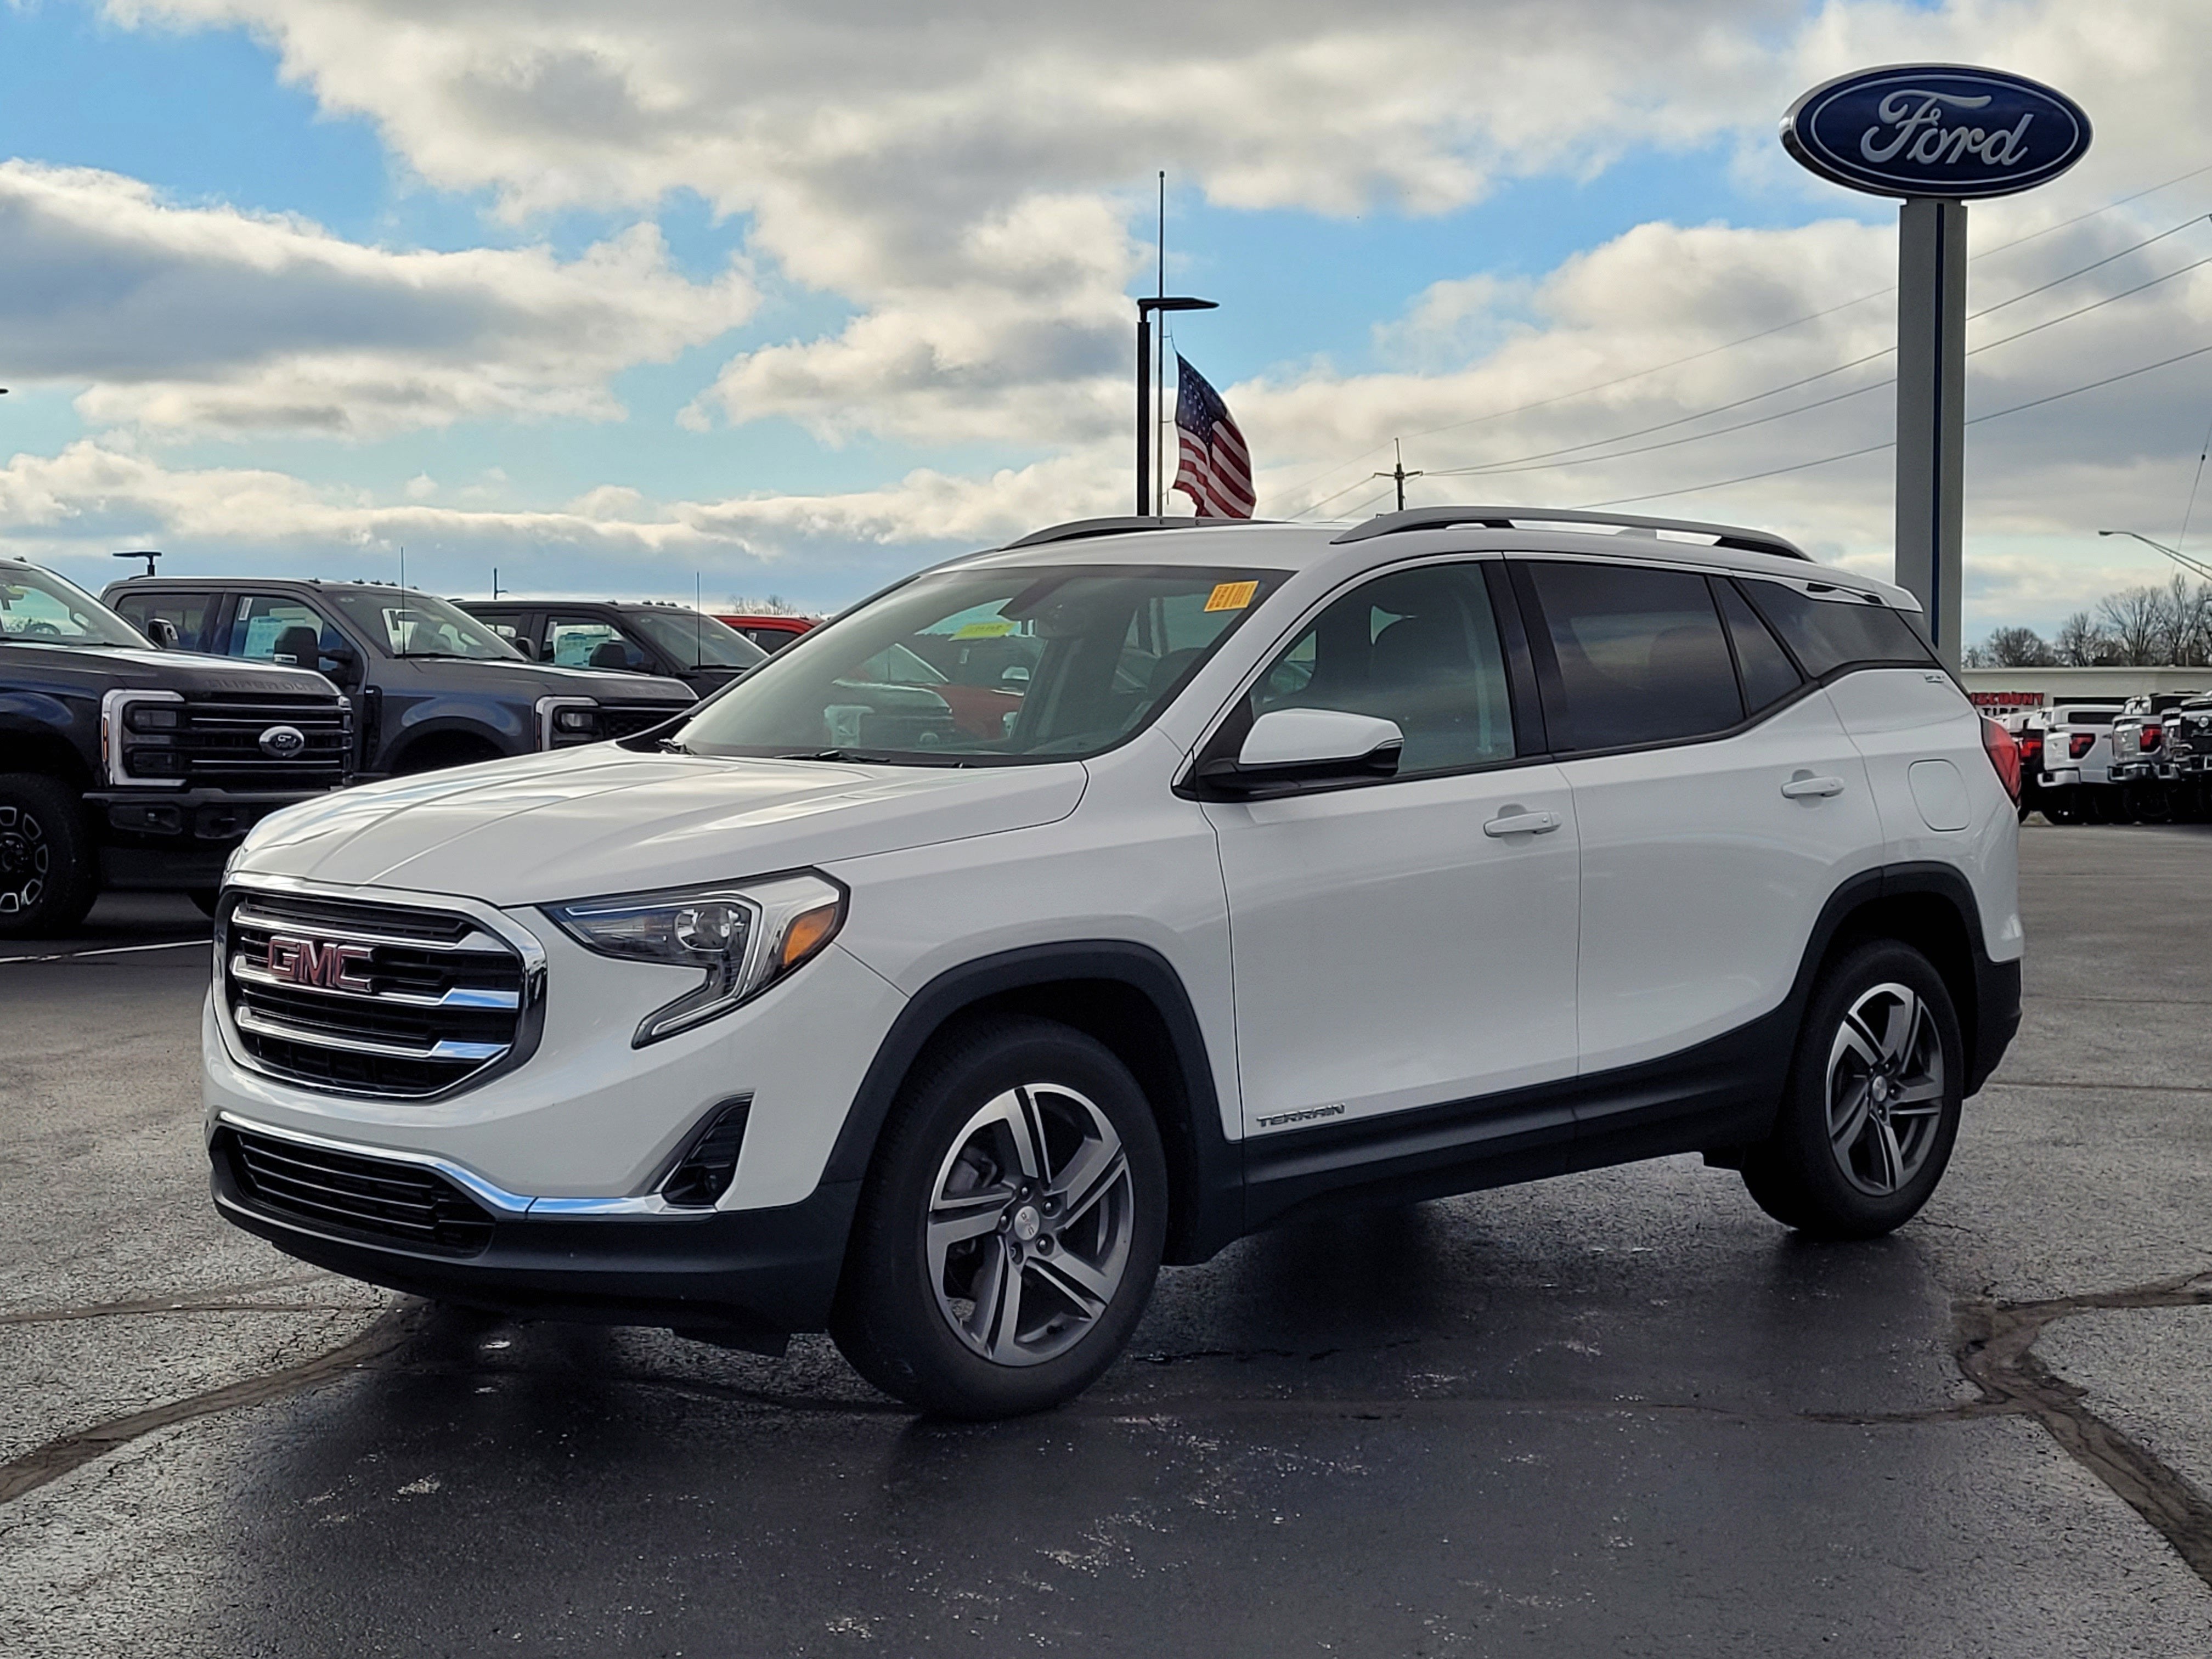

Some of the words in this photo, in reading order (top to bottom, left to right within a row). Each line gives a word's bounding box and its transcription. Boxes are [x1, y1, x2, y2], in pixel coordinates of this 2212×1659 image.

[1860, 89, 2034, 165] Ford
[1970, 691, 2044, 706] ISCOUNT
[268, 935, 374, 992] GMC
[1256, 1103, 1345, 1127] TERRAIN
